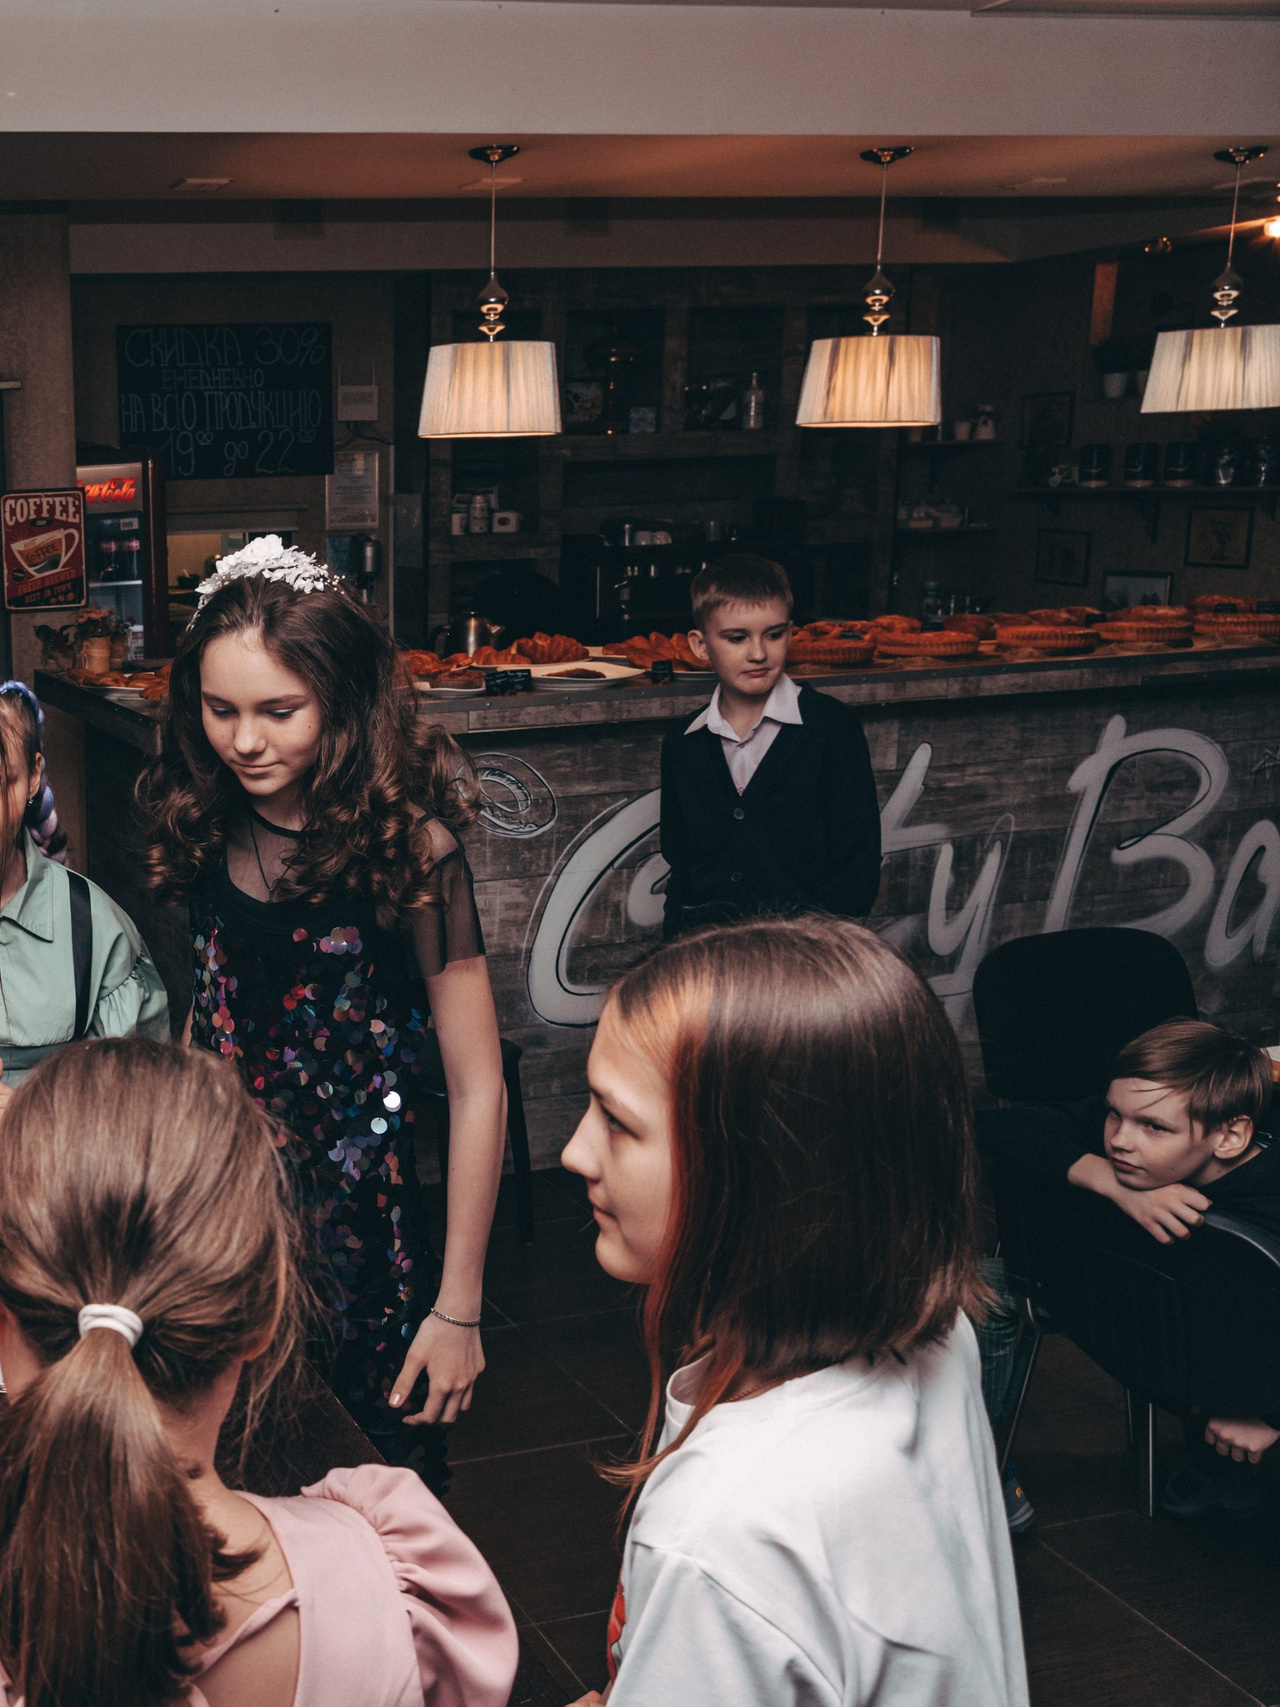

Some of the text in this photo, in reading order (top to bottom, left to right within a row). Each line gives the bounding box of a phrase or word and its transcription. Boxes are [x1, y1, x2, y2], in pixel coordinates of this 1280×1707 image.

[125, 326, 326, 368] СКИДКА 30%
[161, 368, 264, 390] ЕЖЕДНЕВНО
[121, 390, 321, 432] НА ВСЮ ПРОДУКЦИЮ
[4, 496, 80, 527] COFFEE
[26, 543, 58, 563] COFFEE
